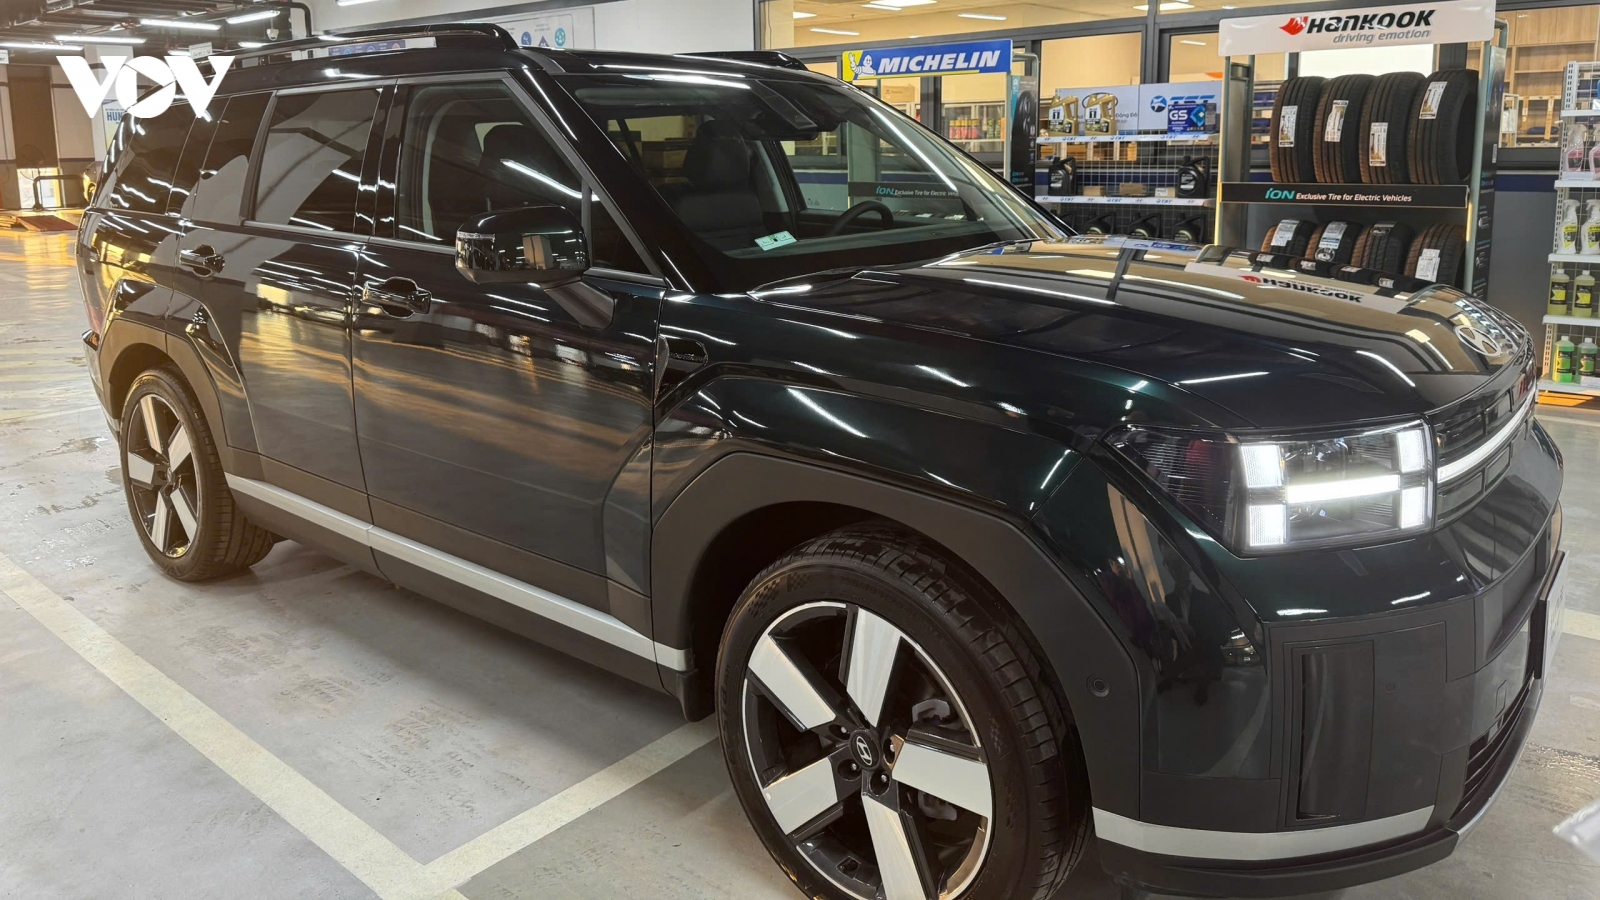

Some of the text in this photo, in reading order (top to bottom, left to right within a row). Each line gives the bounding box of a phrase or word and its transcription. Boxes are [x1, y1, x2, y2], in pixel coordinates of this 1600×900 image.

[1333, 29, 1430, 44] driving emotion
[877, 50, 1001, 74] MICHELIN
[1169, 109, 1188, 121] GS
[1296, 192, 1327, 200] Exclusive
[1382, 194, 1412, 202] Vehicles
